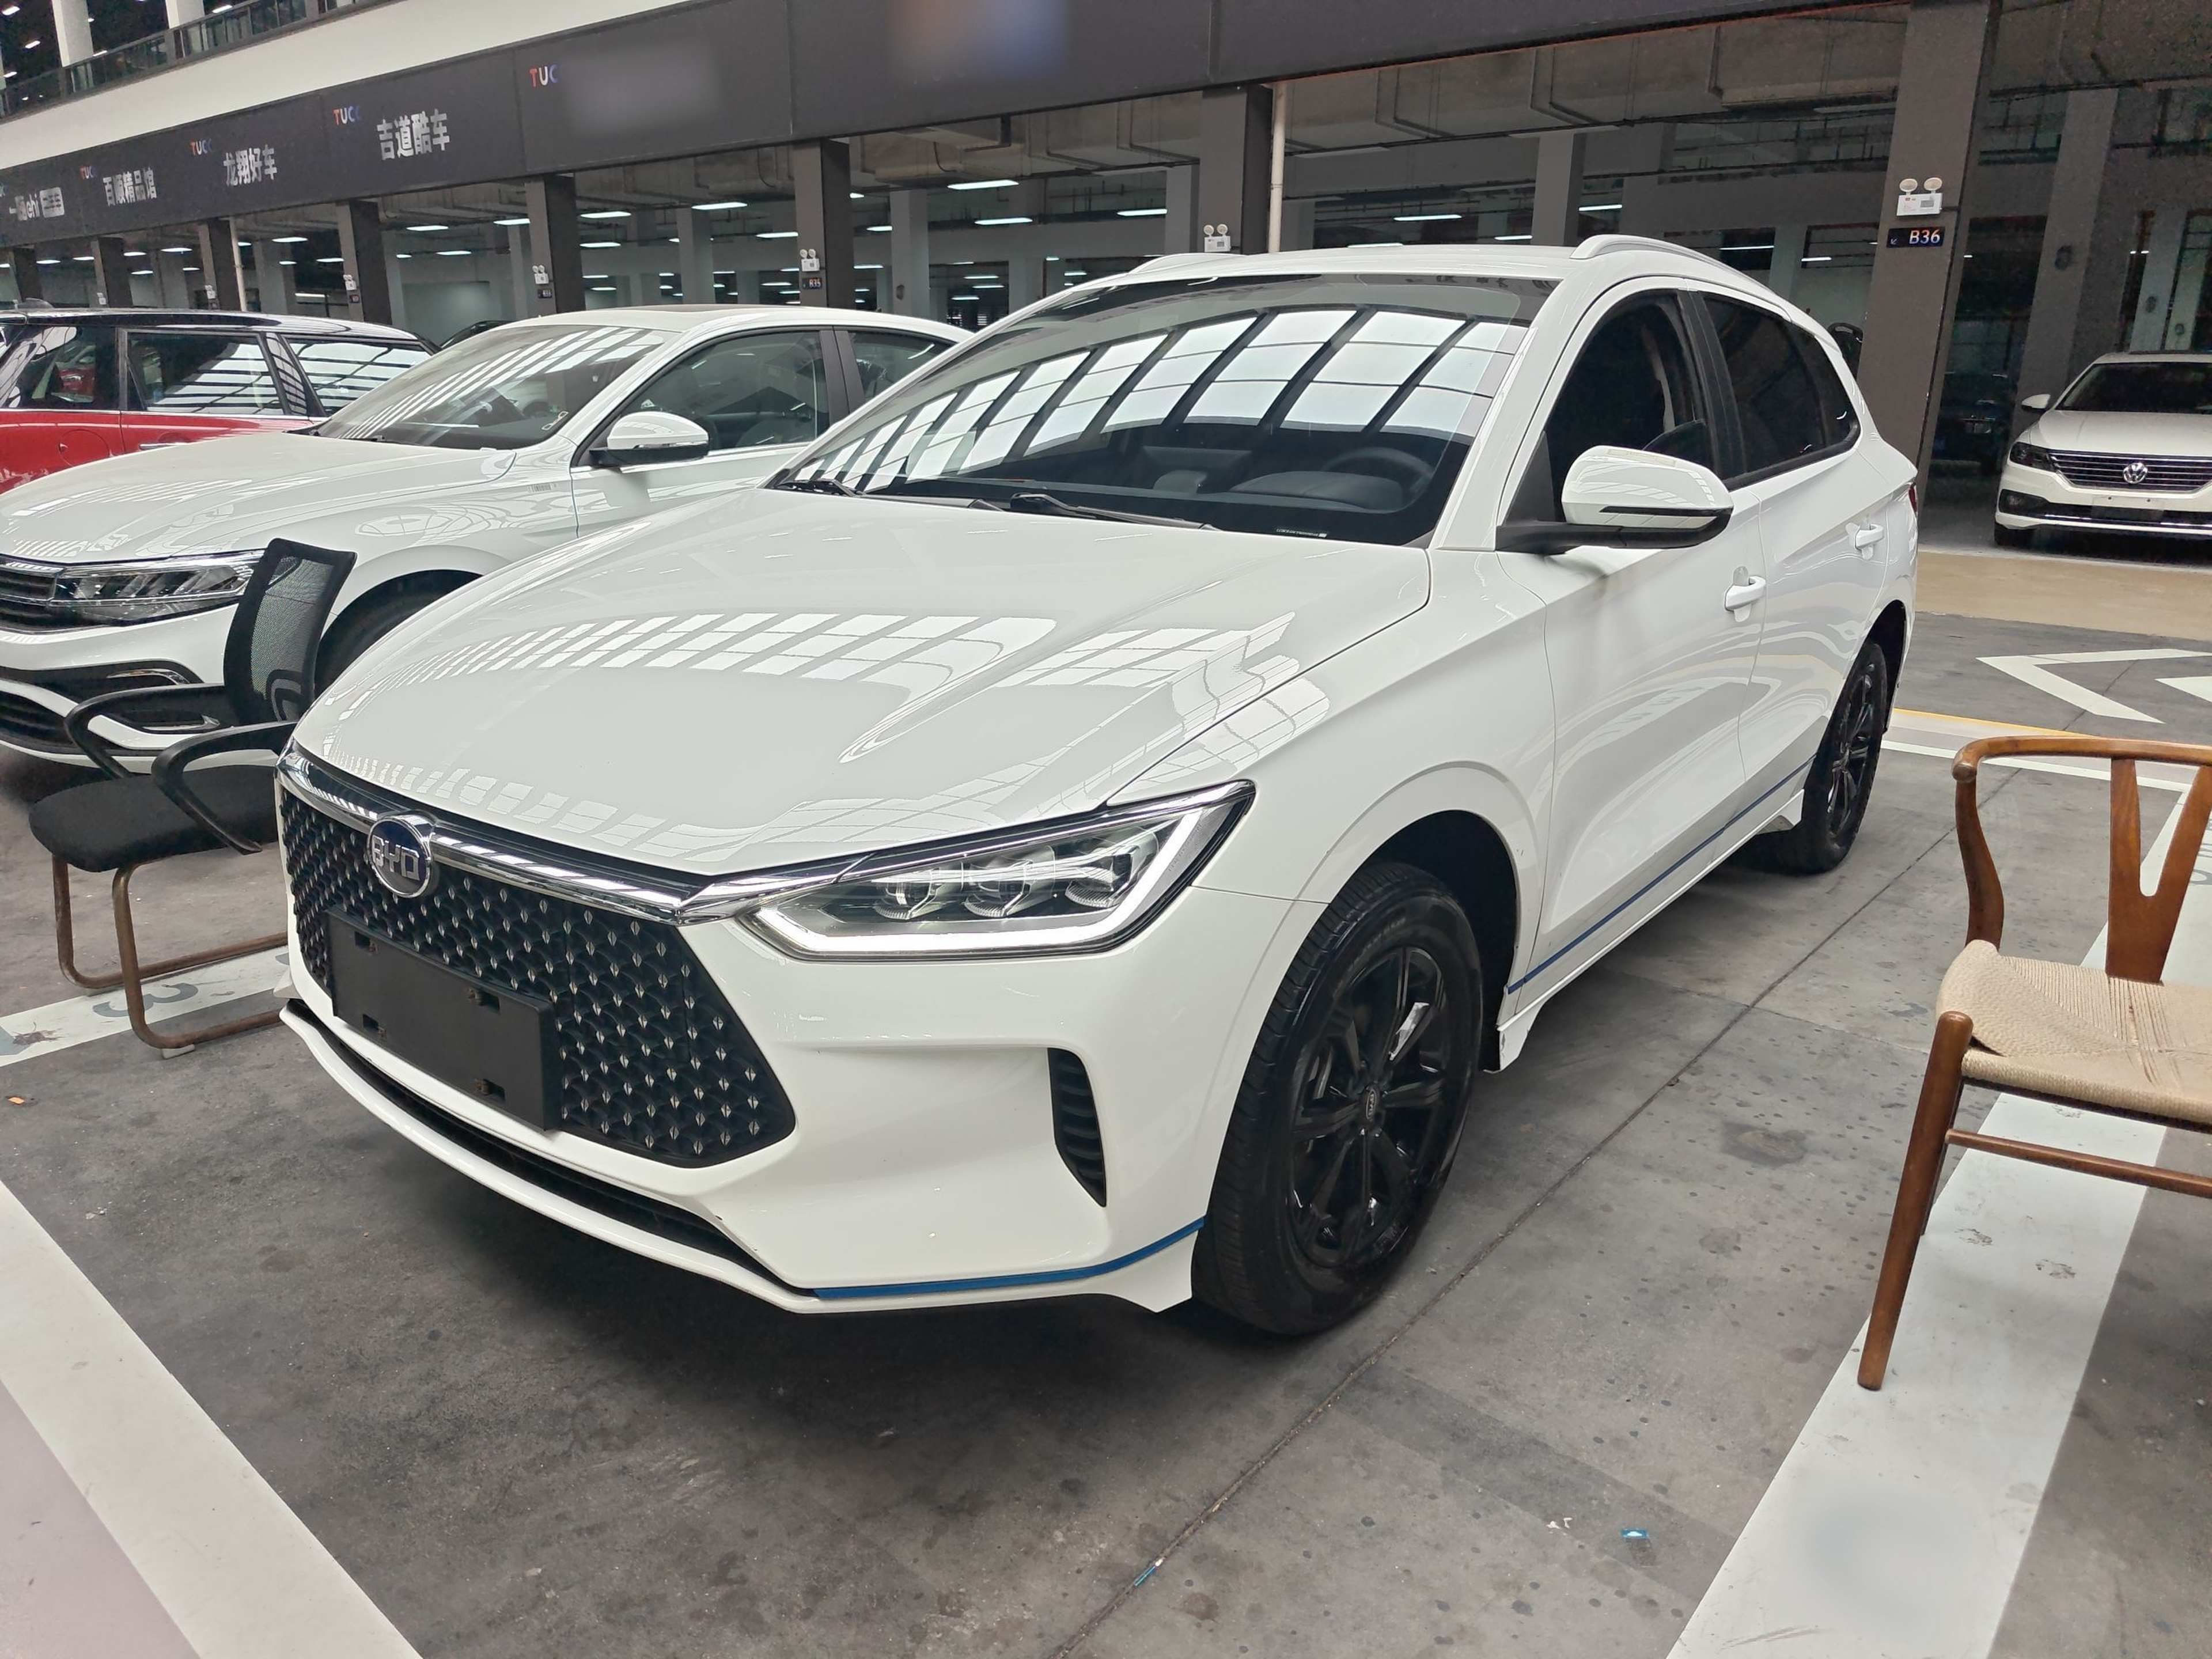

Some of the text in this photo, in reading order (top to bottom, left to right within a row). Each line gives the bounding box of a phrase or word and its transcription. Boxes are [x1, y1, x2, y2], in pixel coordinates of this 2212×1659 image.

[529, 63, 561, 88] TUC
[377, 108, 450, 160] 吉道酷车
[224, 145, 277, 187] 龙翔好车
[1909, 229, 1941, 244] B36
[372, 835, 420, 880] BYD
